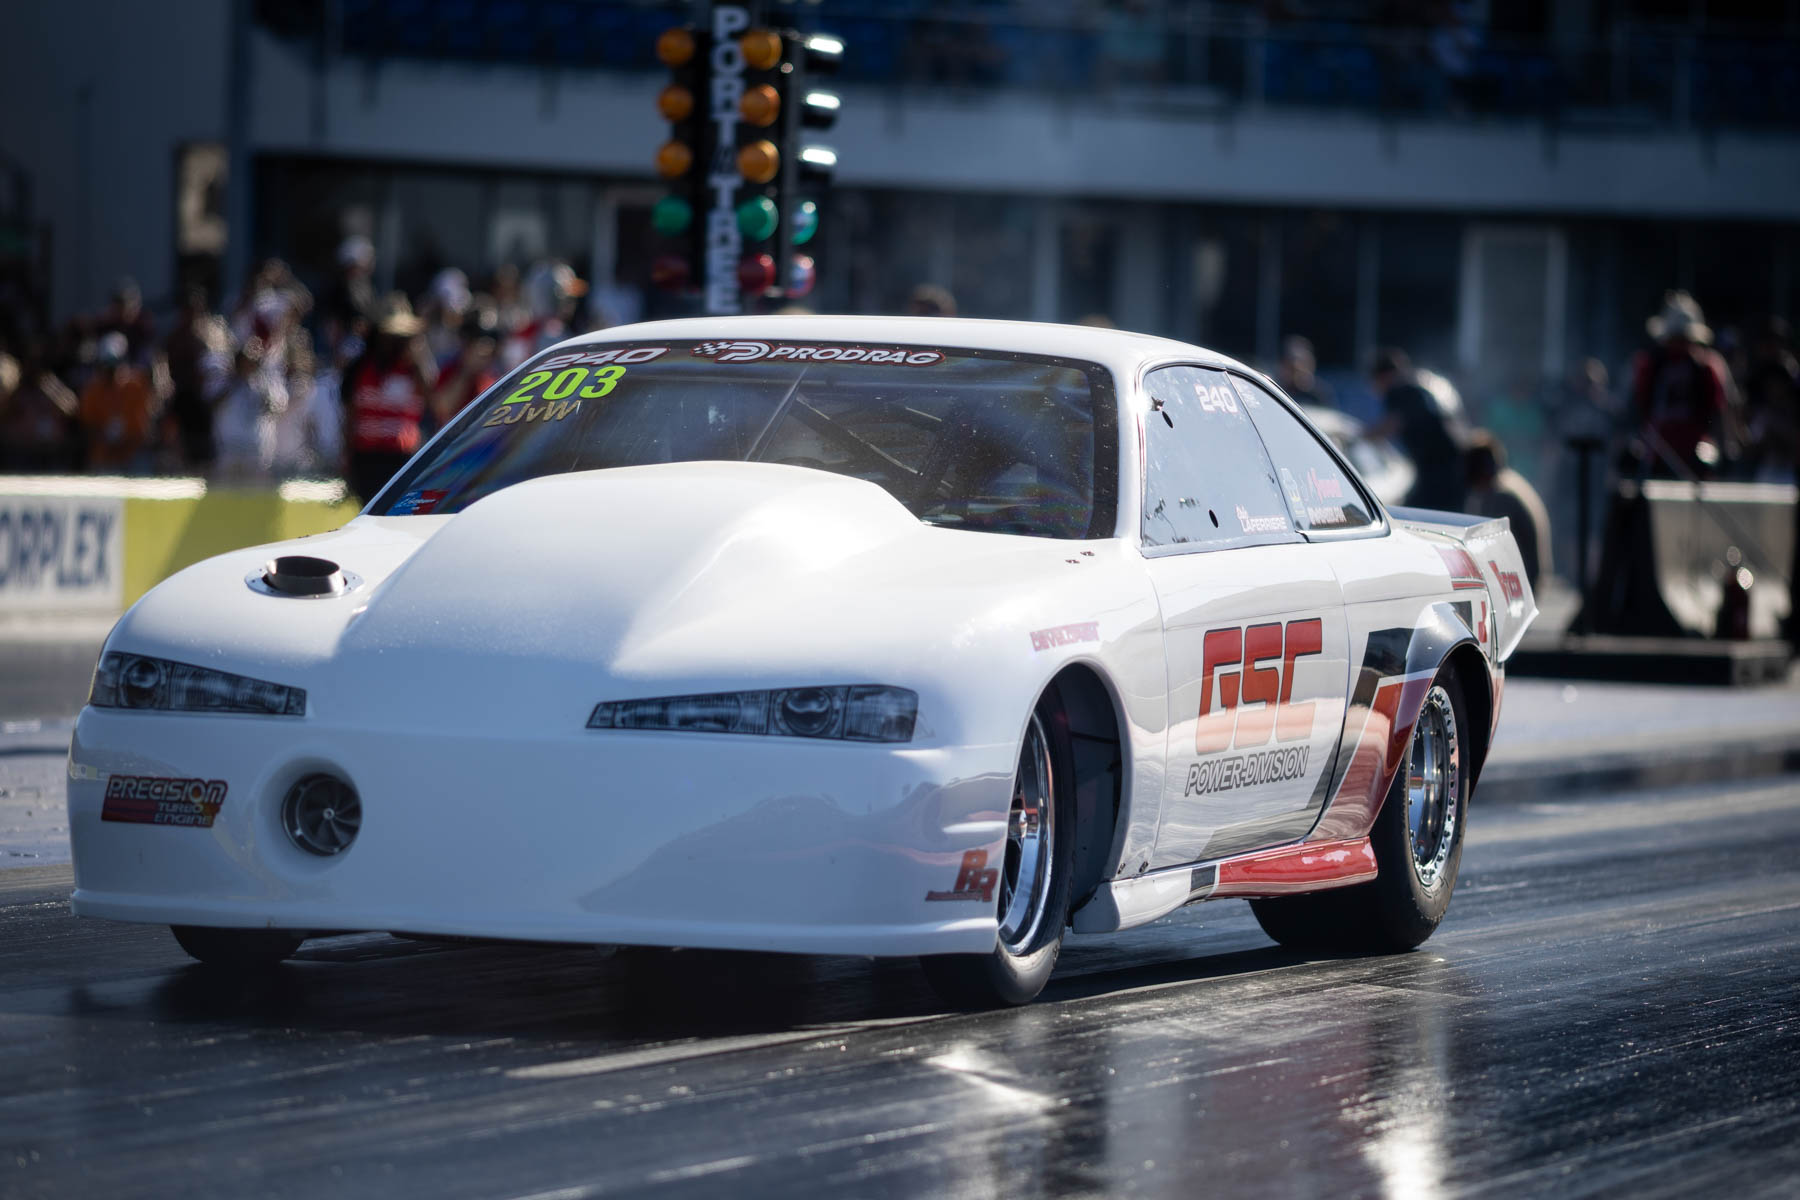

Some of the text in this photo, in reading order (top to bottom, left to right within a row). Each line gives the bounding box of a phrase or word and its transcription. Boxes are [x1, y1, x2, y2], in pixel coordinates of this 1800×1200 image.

[529, 347, 668, 373] 240
[766, 346, 942, 366] PRODRAG
[502, 365, 626, 405] 203
[1195, 384, 1239, 414] 240
[1185, 746, 1310, 797] POWER-DIVISION
[107, 777, 228, 803] PRECISION
[158, 802, 204, 814] TURBO
